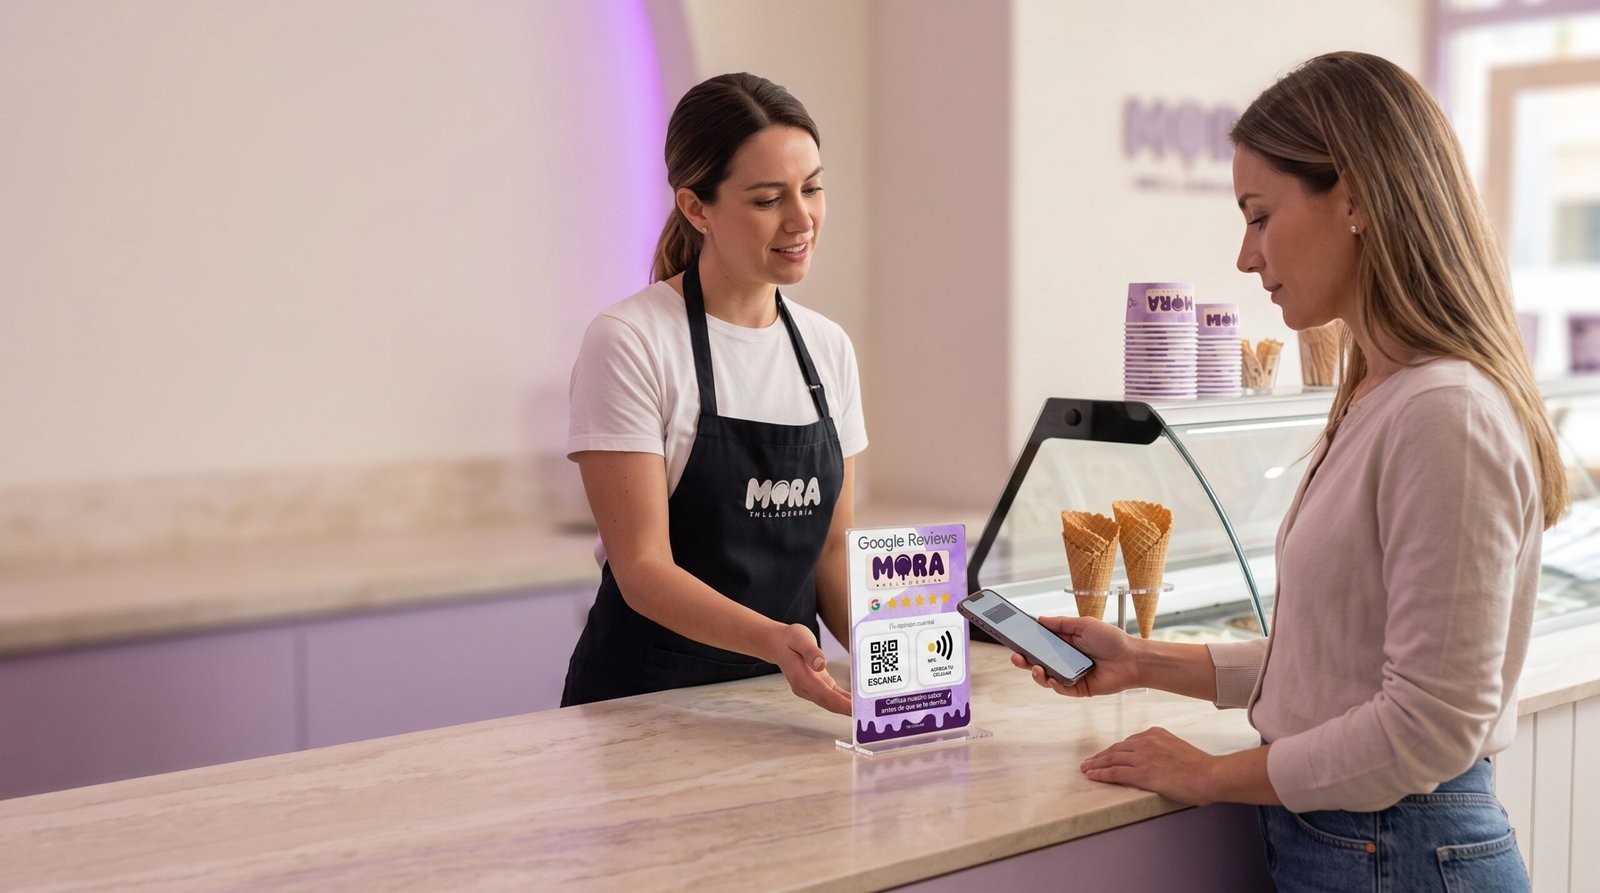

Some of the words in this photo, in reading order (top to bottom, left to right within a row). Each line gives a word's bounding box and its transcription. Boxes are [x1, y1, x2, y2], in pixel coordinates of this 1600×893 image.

[745, 477, 821, 510] MORA
[858, 534, 904, 552] Google
[908, 531, 958, 546] Reviews
[872, 552, 945, 581] MORA
[868, 675, 902, 687] ESCANEA
